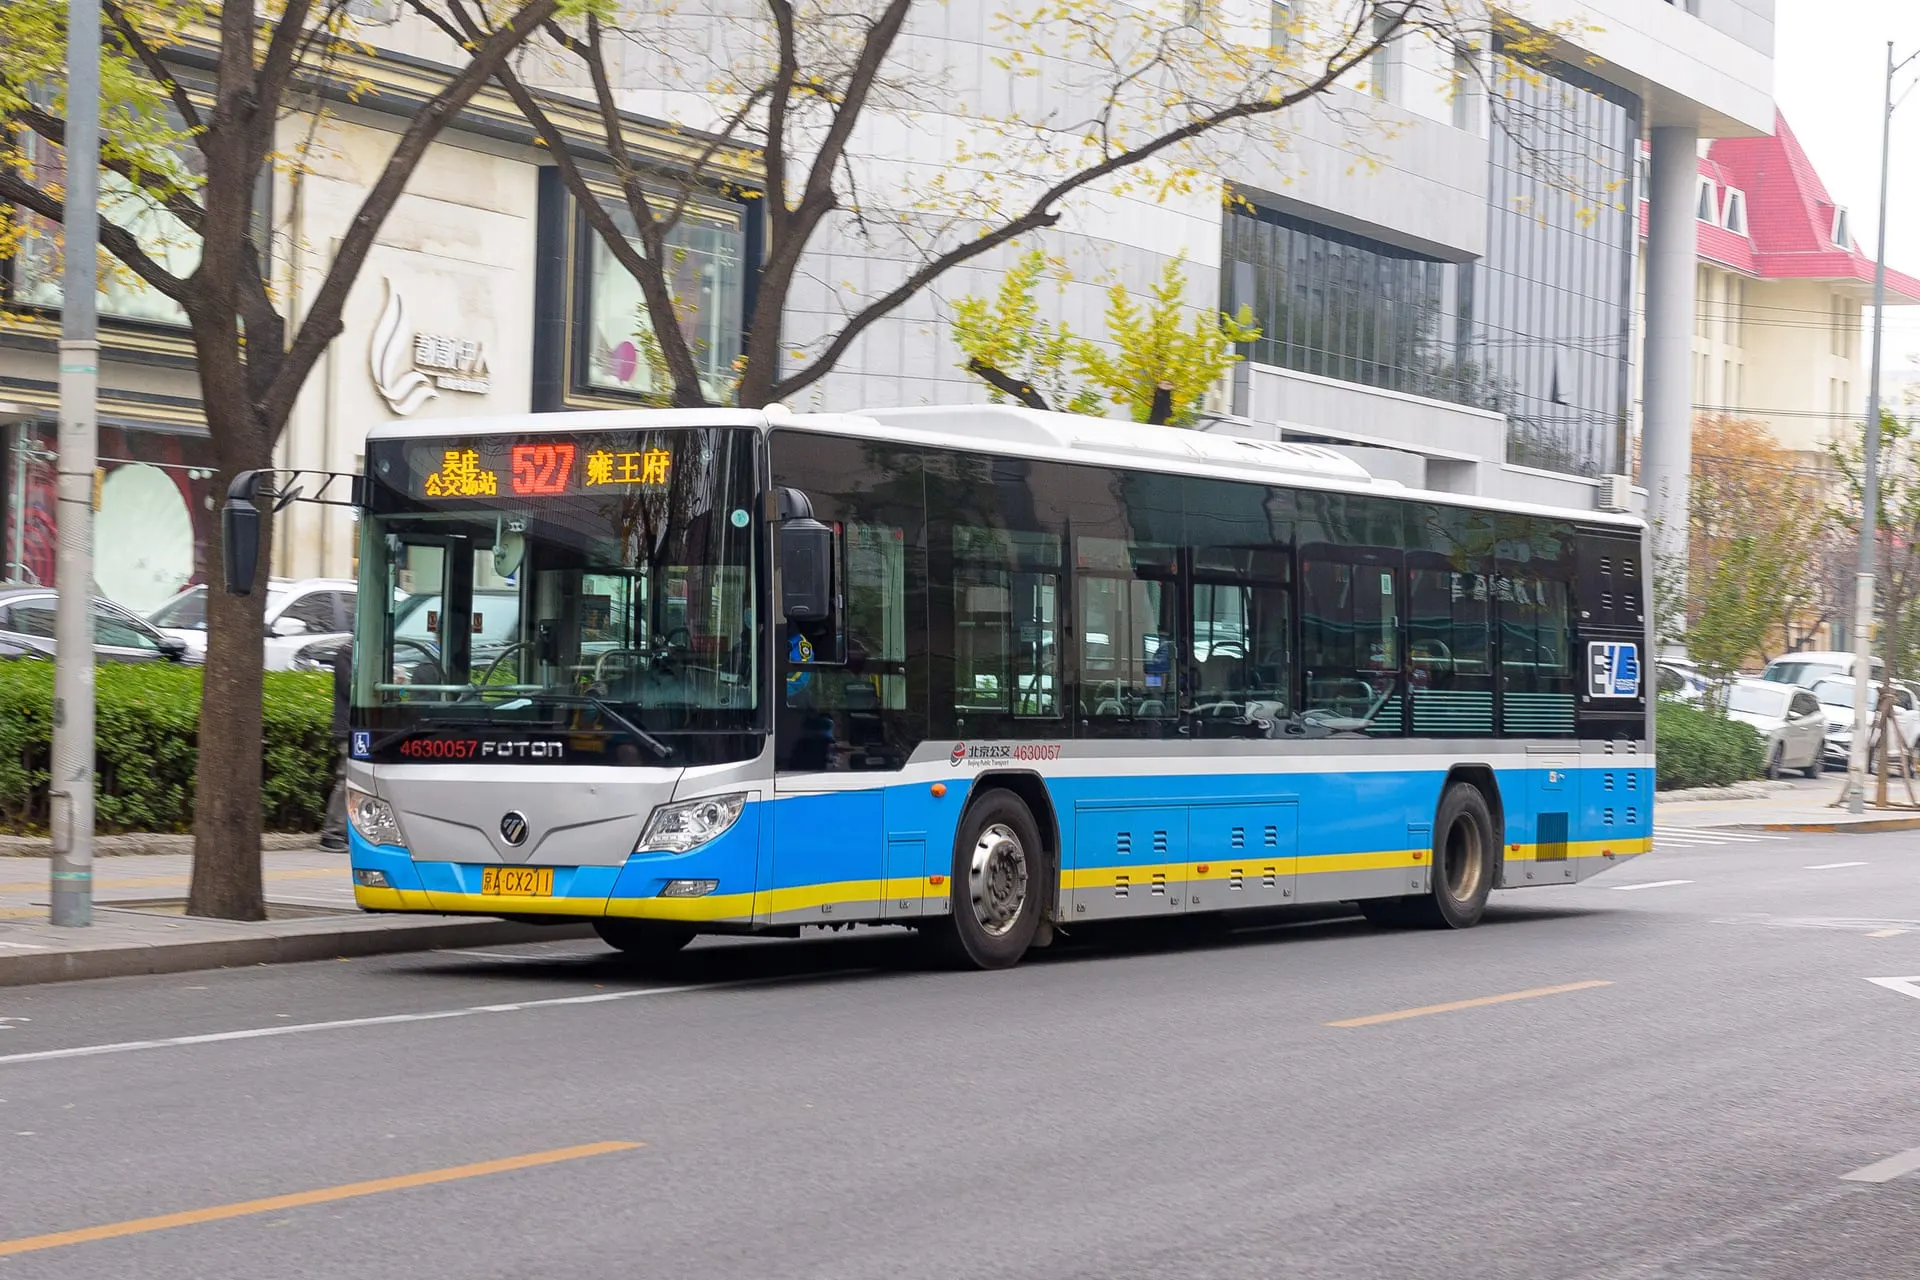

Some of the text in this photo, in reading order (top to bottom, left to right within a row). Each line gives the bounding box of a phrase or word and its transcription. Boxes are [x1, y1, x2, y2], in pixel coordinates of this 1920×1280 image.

[442, 449, 480, 474] 吴庄
[511, 444, 575, 496] 527
[586, 448, 671, 487] 雍王府
[424, 471, 498, 497] 公交场站
[400, 739, 478, 758] 4630057
[481, 740, 563, 757] FOTON
[968, 745, 1011, 758] 北京公交
[1013, 744, 1061, 760] 4630057
